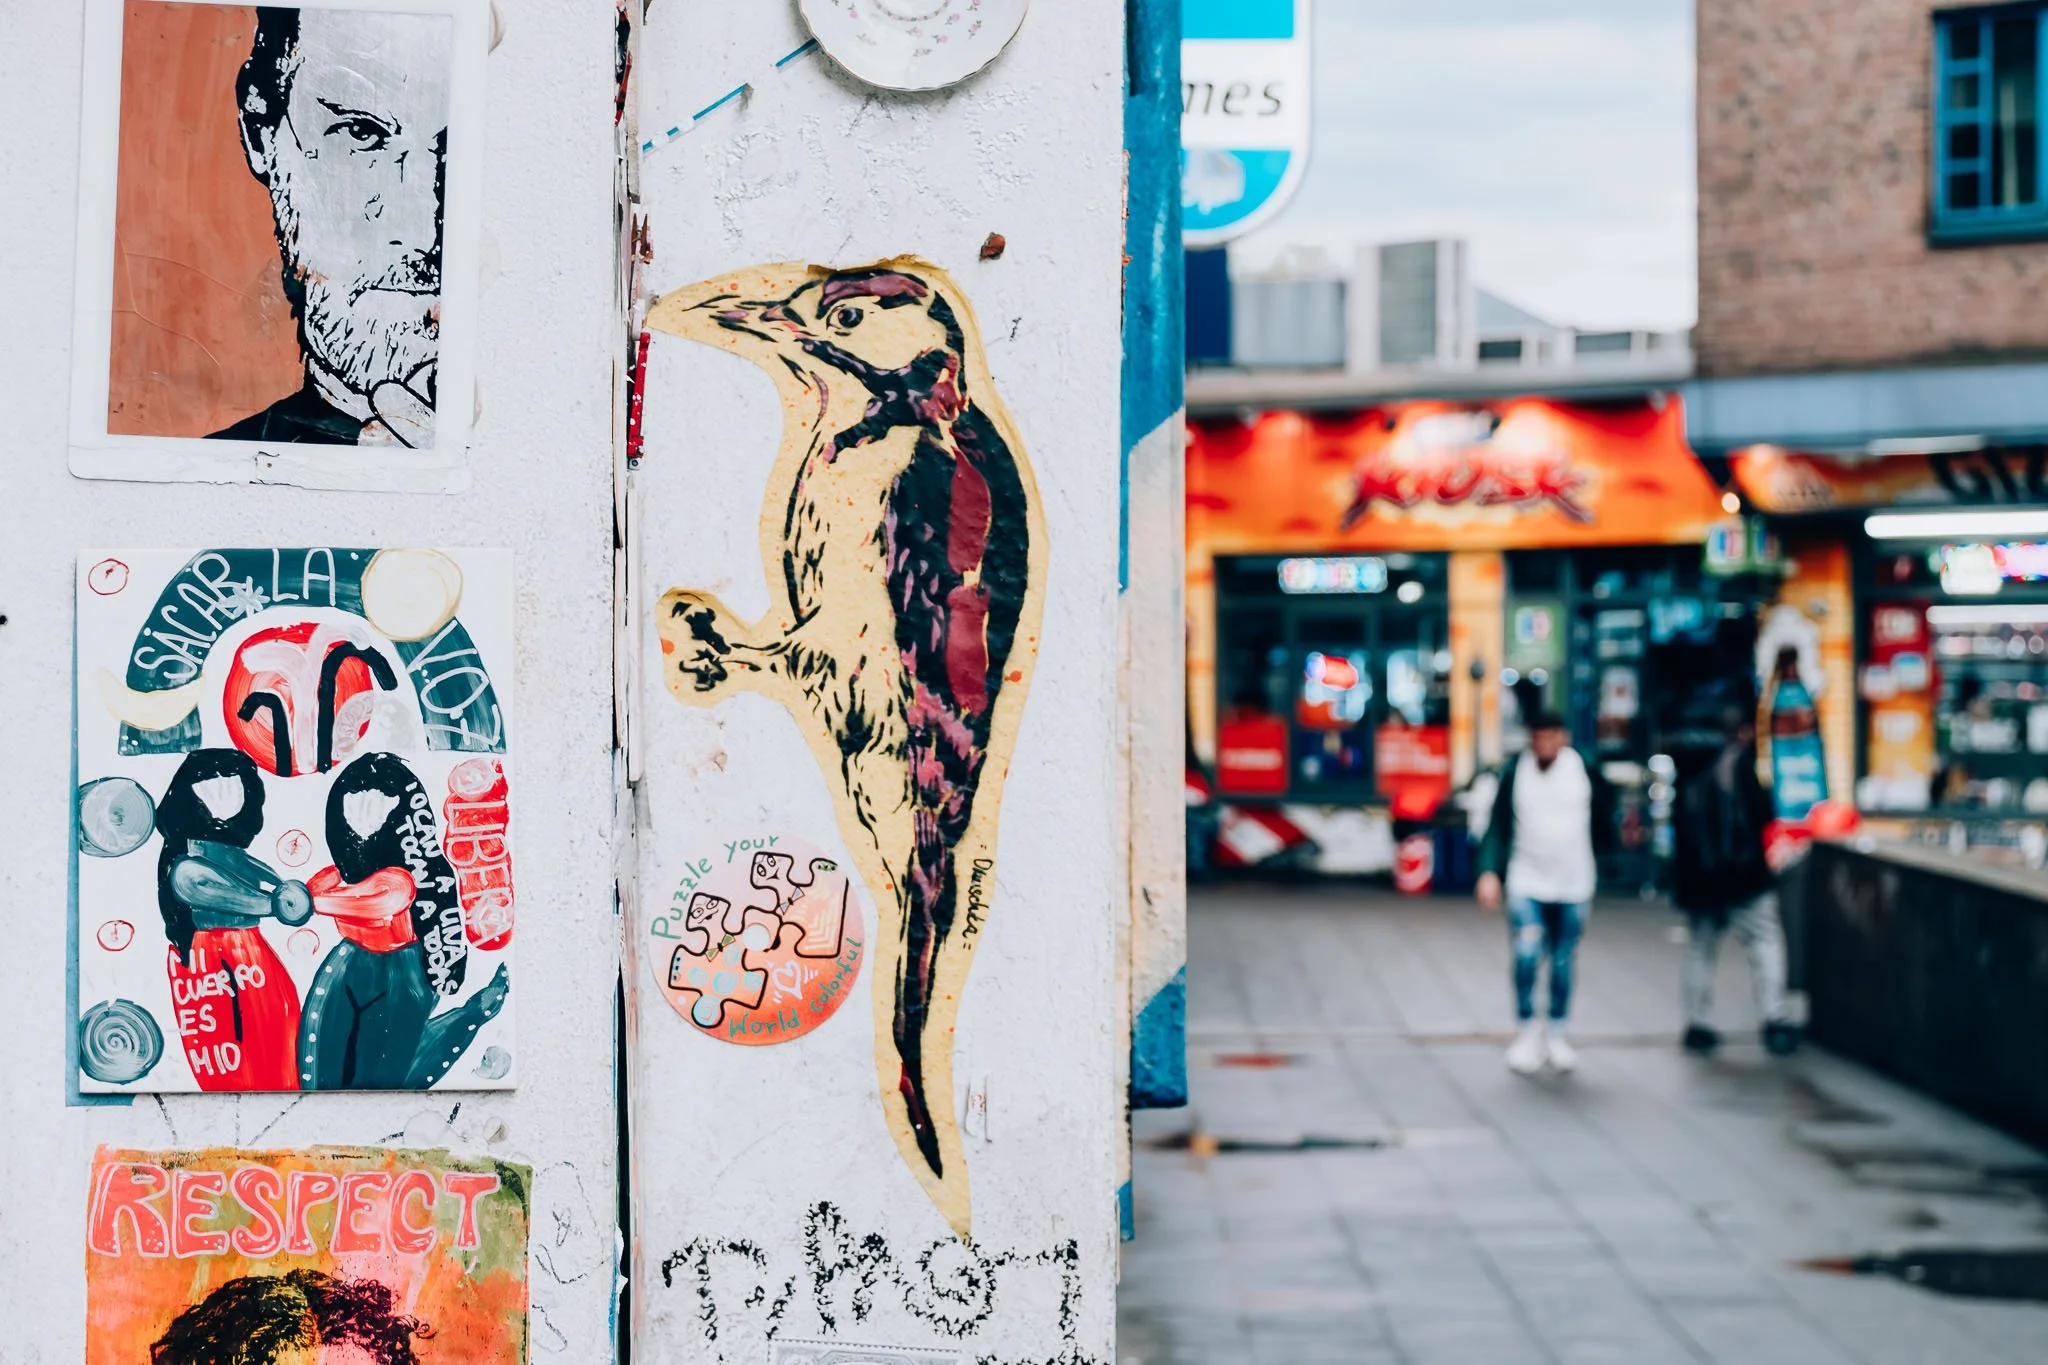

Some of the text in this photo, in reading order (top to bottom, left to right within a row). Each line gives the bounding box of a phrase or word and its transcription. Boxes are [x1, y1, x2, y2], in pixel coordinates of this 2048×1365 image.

[272, 547, 337, 606] LA
[435, 876, 456, 893] A
[447, 800, 513, 948] LIBERA
[651, 835, 779, 940] Puzzle your
[416, 900, 438, 920] A
[439, 907, 466, 969] UNA
[424, 925, 458, 996] TODAS
[179, 1003, 217, 1036] ES
[729, 1007, 800, 1038] World
[189, 1041, 241, 1075] MIO
[88, 1161, 501, 1260] RESPECT
